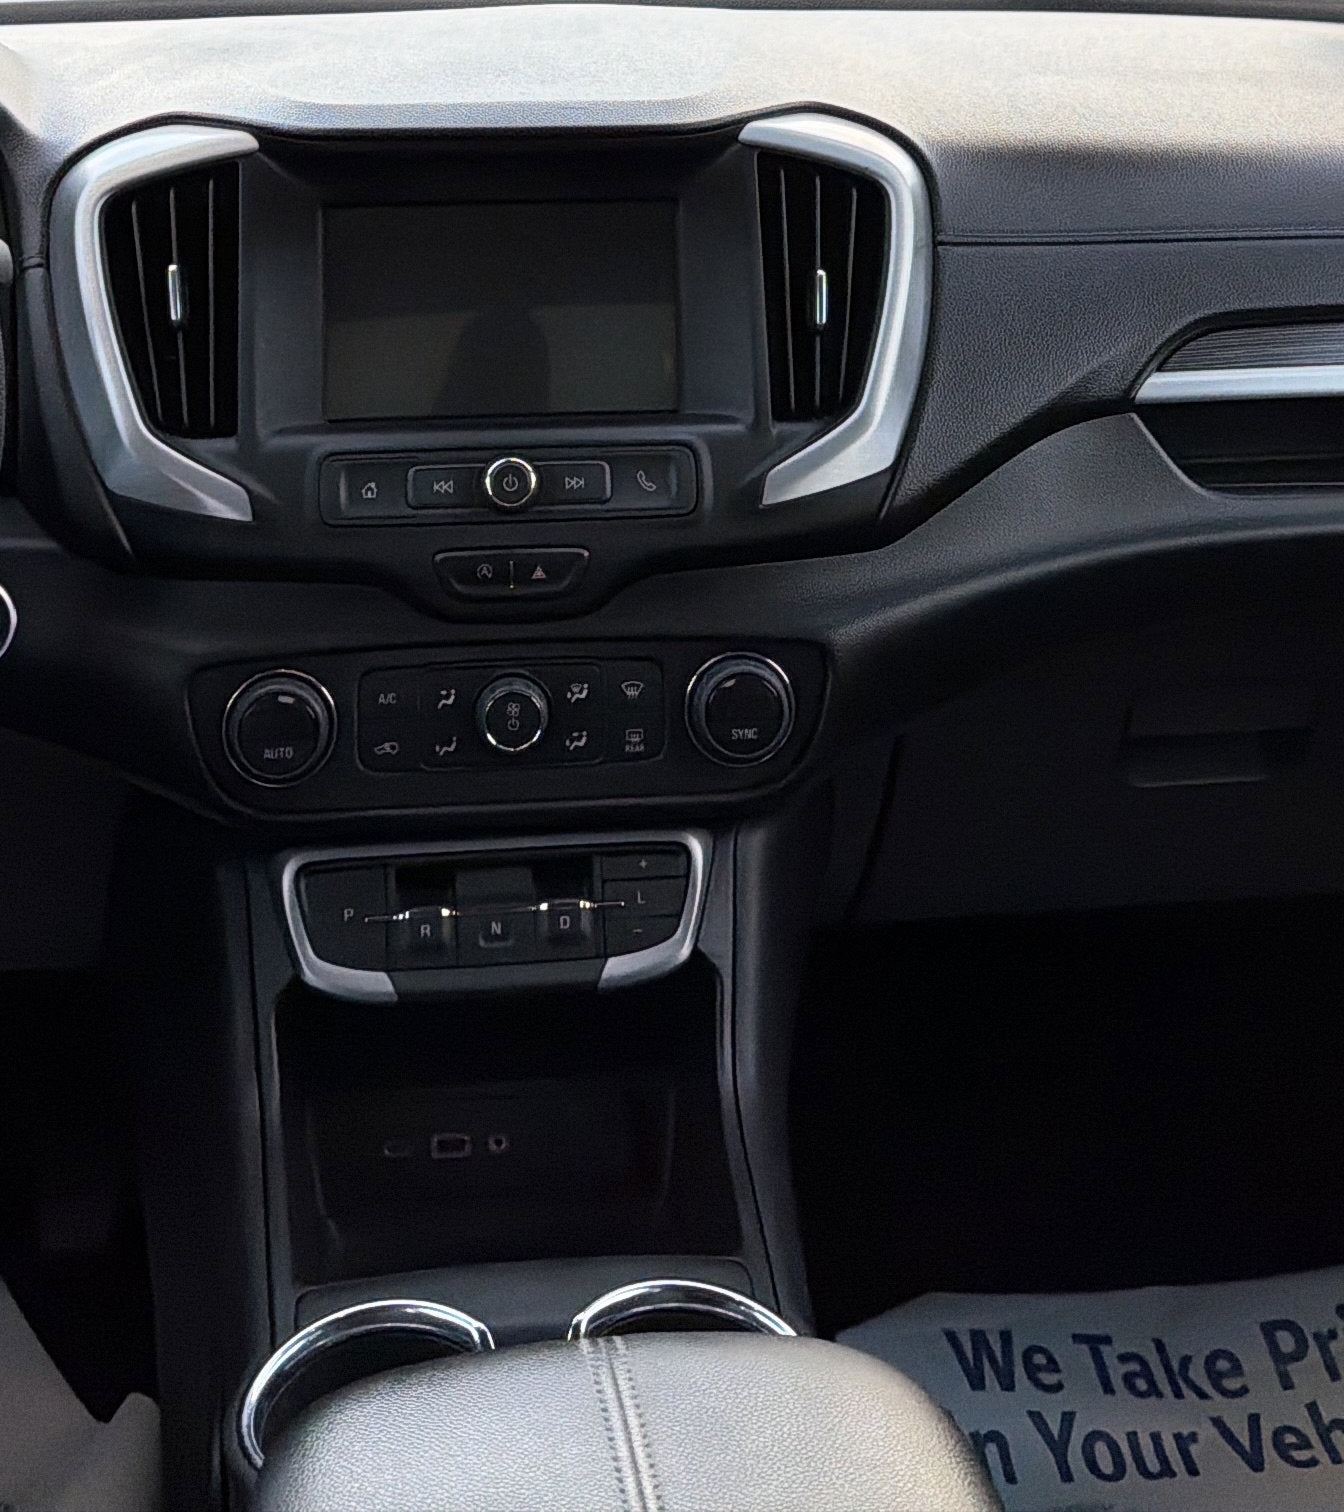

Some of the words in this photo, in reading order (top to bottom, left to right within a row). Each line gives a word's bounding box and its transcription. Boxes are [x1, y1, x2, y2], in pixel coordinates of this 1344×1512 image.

[378, 693, 397, 705] A/C
[731, 728, 758, 740] SYNC
[263, 747, 294, 760] AUTO
[343, 908, 354, 922] P
[559, 915, 570, 929] D
[420, 924, 431, 938] R
[491, 921, 502, 935] N
[944, 1324, 1066, 1396] We
[1072, 1330, 1249, 1401] Take
[968, 1430, 1019, 1487] n
[1027, 1408, 1202, 1484] Your
